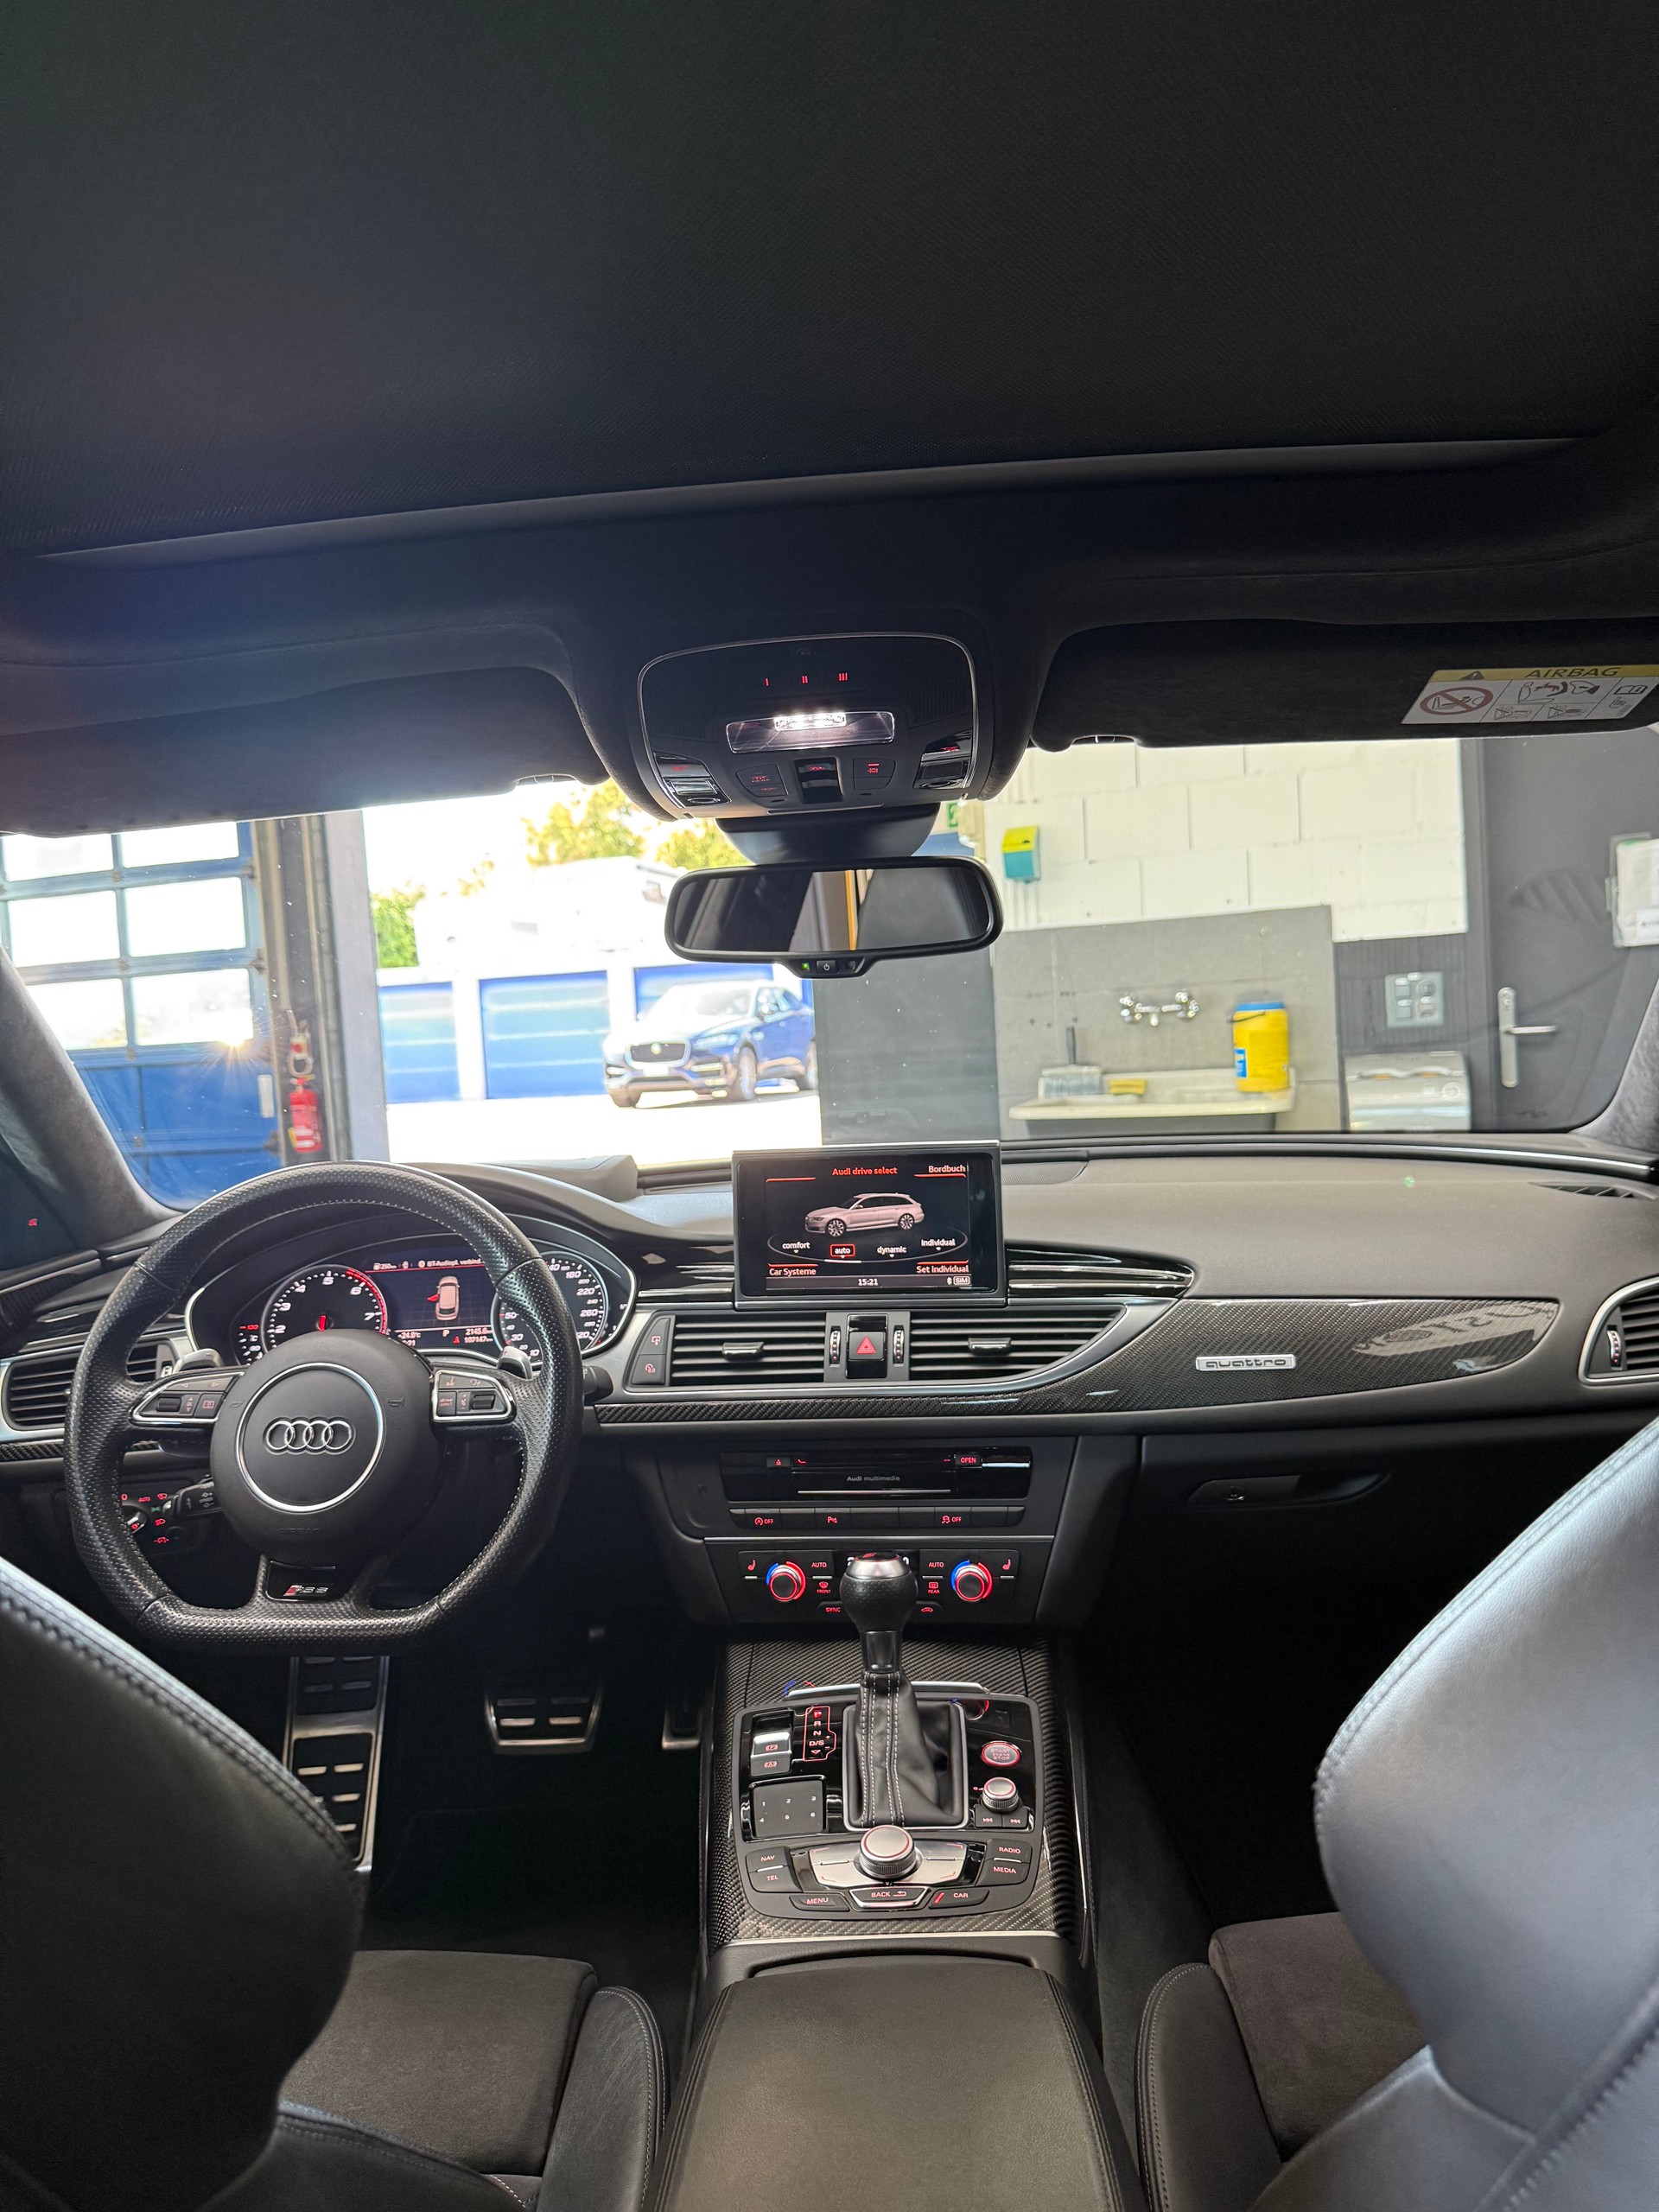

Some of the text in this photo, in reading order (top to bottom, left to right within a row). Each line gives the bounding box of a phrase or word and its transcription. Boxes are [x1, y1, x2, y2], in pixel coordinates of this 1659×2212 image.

[1524, 667, 1622, 678] AIRBAG
[832, 1166, 898, 1176] Audi drive select
[928, 1164, 966, 1174] Bordbuch
[876, 1246, 907, 1255] dynamic
[785, 1267, 817, 1276] Systeme
[916, 1265, 931, 1274] Set
[322, 1276, 334, 1285] 5
[857, 1278, 879, 1287] 15:21
[294, 1284, 307, 1294] 4
[349, 1286, 362, 1295] 6
[576, 1287, 595, 1296] 220
[278, 1302, 292, 1312] 3
[364, 1312, 375, 1321] 7
[580, 1308, 599, 1317] 260
[274, 1325, 287, 1334] 2
[511, 1333, 524, 1342] 30
[1205, 1358, 1287, 1369] quattro
[998, 1846, 1021, 1854] RADIO
[993, 1866, 1017, 1874] MEDIA
[806, 1897, 829, 1905] MENU
